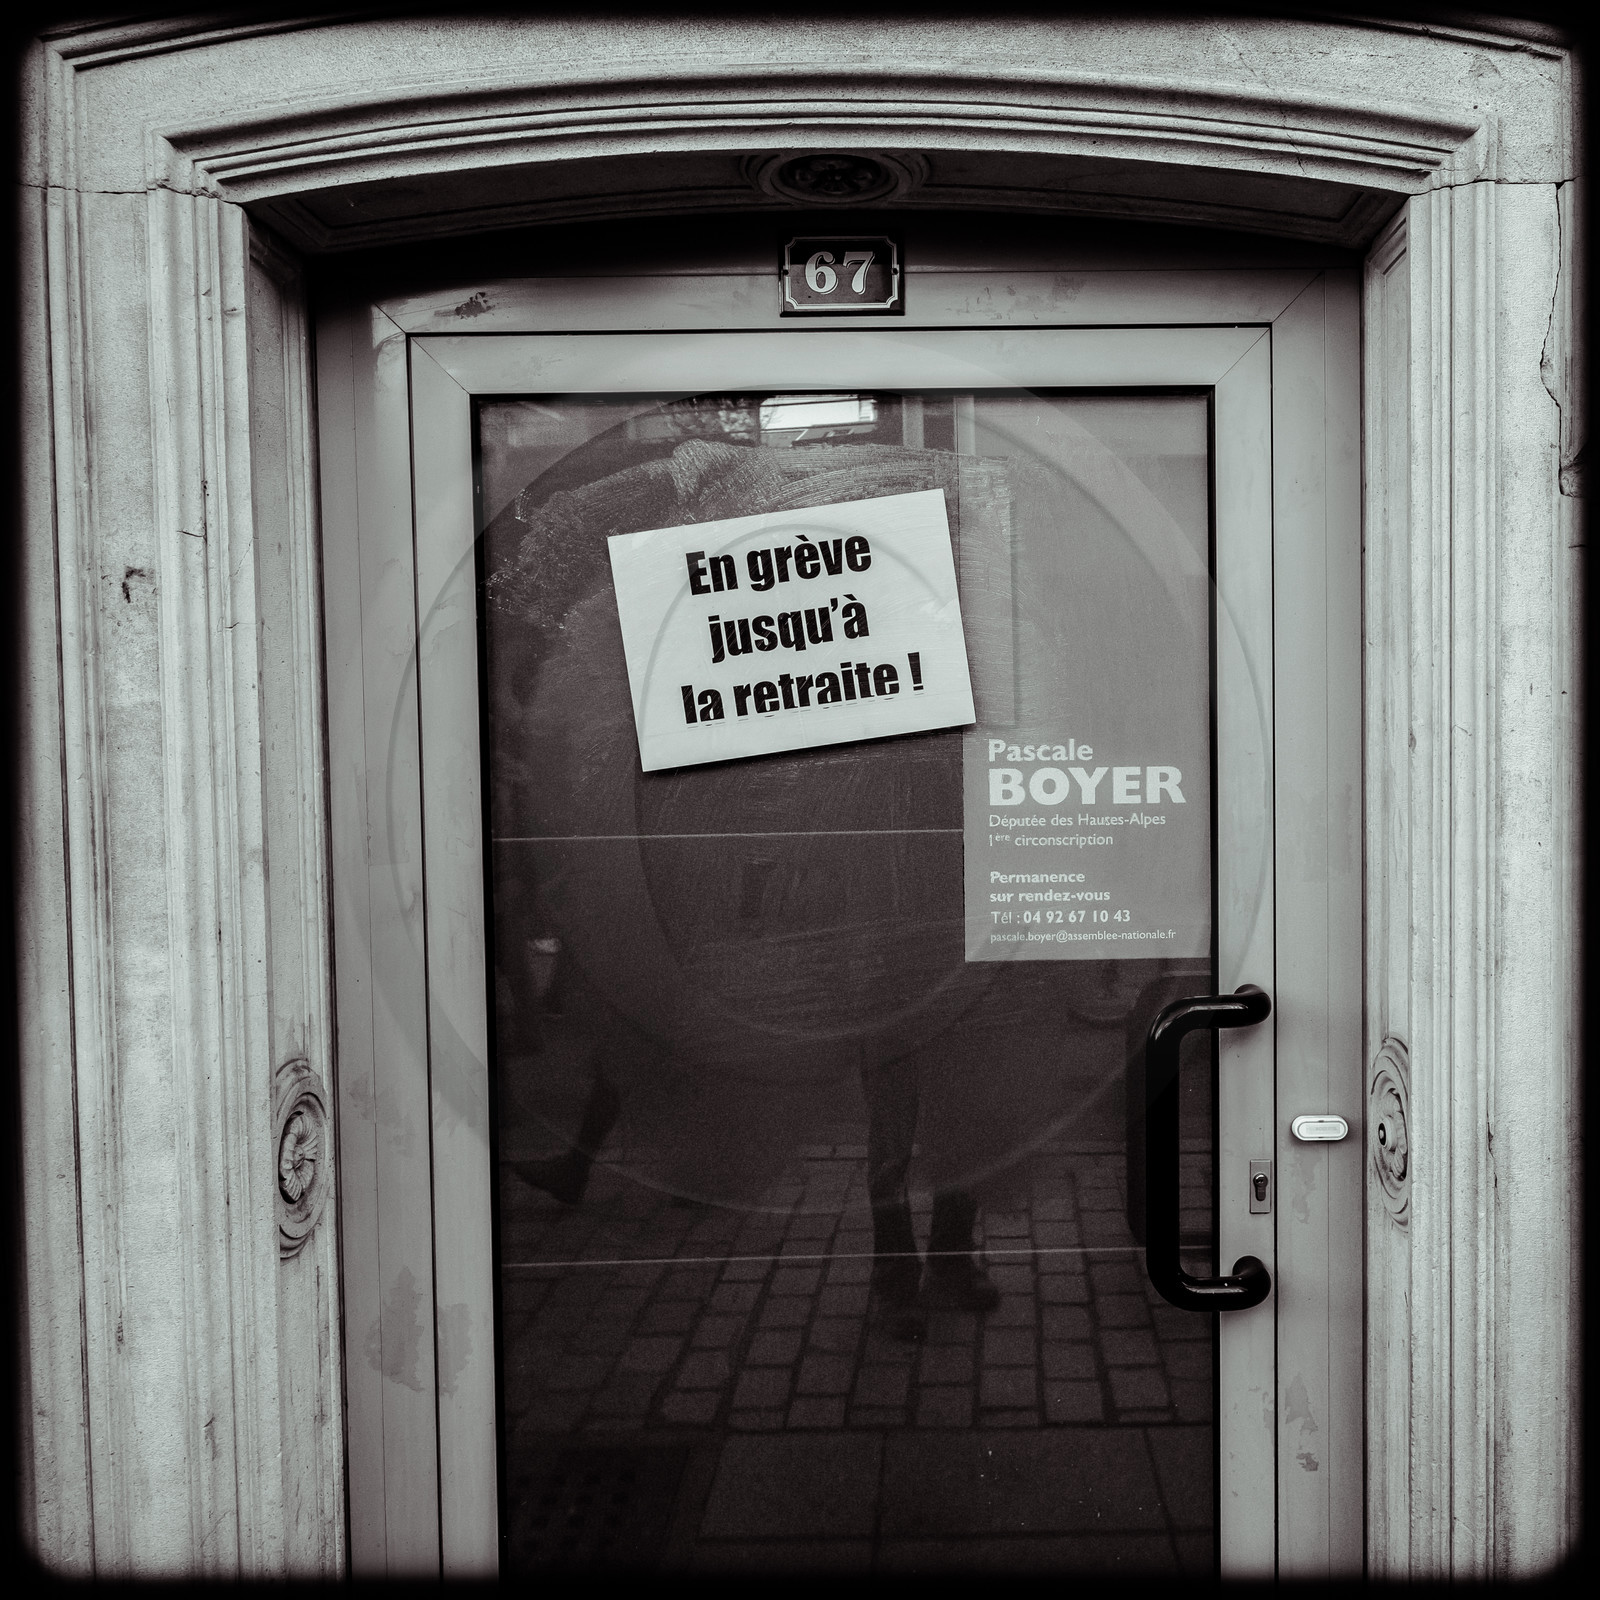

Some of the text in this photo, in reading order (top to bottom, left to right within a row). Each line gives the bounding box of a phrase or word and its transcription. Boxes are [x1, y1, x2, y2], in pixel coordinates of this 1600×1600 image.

[805, 251, 876, 295] 67
[686, 534, 872, 596] En grève
[681, 652, 924, 727] la retraite !
[988, 738, 1093, 762] Pascale
[989, 766, 1186, 806] BOYER
[989, 813, 1166, 830] Députée des Hautes-Alpes
[1015, 834, 1113, 848] circonscription
[990, 872, 1085, 883] Permanence
[990, 890, 1110, 902] sur rendez-vous
[991, 911, 1012, 924] Tél
[1047, 911, 1063, 922] 92
[1068, 911, 1085, 922] 67
[1093, 910, 1108, 922] 10
[1114, 910, 1130, 922] 43
[990, 930, 1176, 944] pascale.boyer@assemblee-nationale.fr
